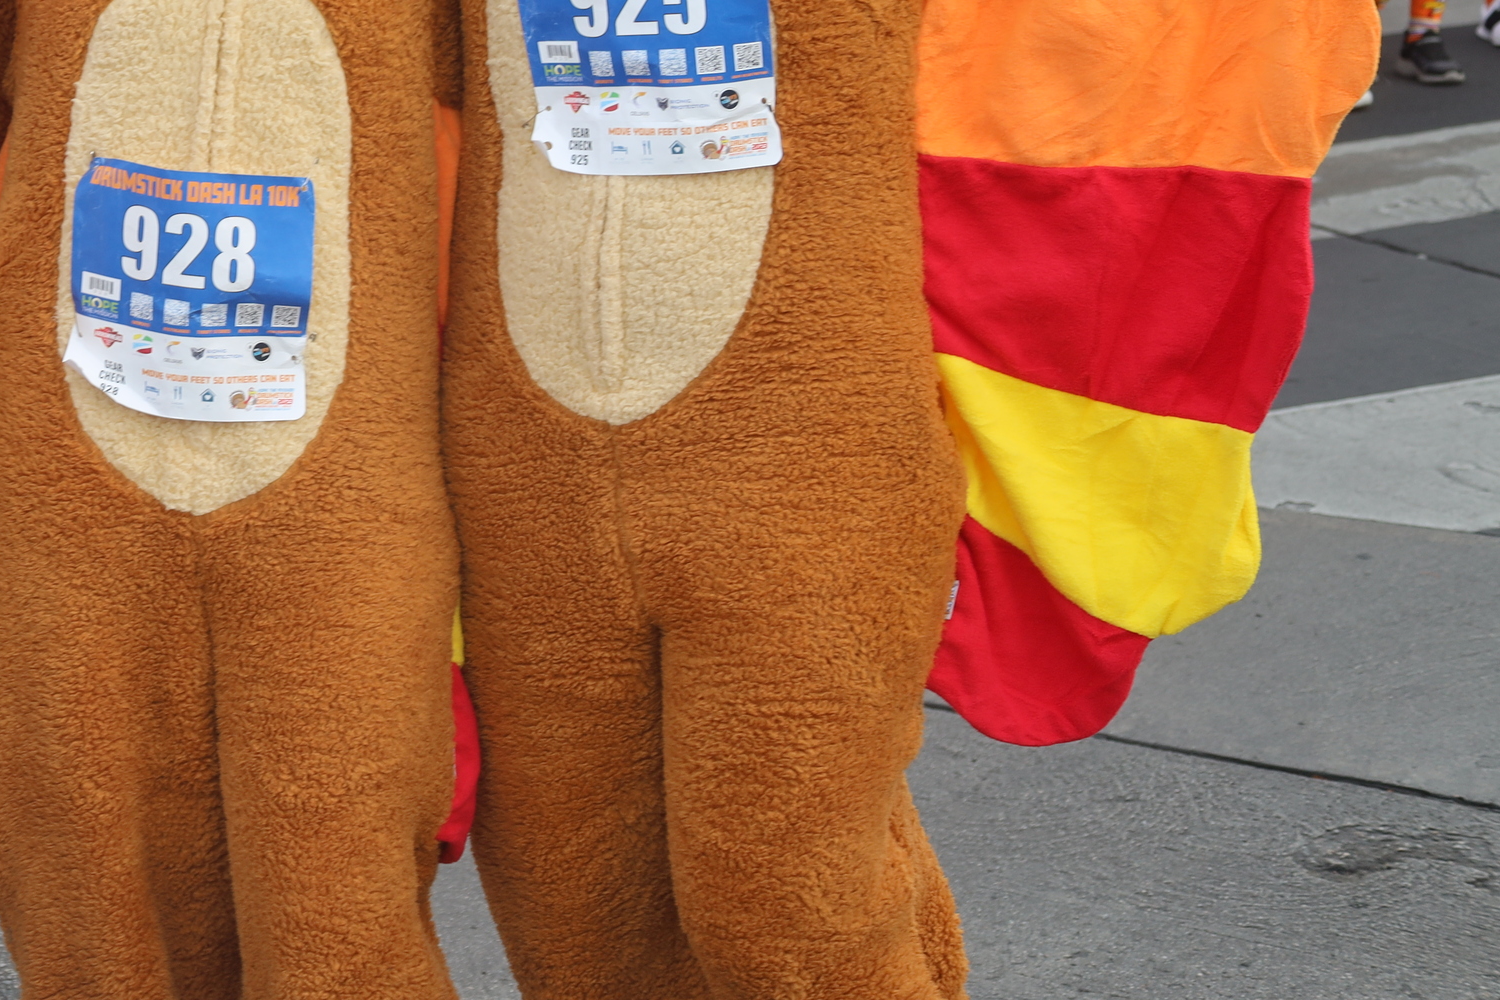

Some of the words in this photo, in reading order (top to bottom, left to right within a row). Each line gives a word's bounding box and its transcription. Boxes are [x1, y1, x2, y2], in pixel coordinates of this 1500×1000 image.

[545, 65, 582, 76] HOPE
[570, 127, 590, 138] GEAR
[608, 127, 631, 136] MOVE
[633, 127, 656, 136] YOUR
[657, 127, 678, 136] FEET
[680, 127, 692, 136] SO
[694, 122, 729, 135] OTHERS
[730, 120, 749, 130] CAN
[750, 118, 768, 127] EAT
[568, 139, 593, 151] CHECK
[570, 154, 589, 166] 925
[90, 165, 183, 202] DRUMSTICK
[186, 181, 235, 205] DASH
[239, 183, 264, 206] LA
[267, 185, 301, 207] 10K
[120, 204, 257, 293] 928
[81, 295, 119, 314] HOPE
[104, 359, 123, 372] GEAR
[98, 370, 126, 385] CHECK
[141, 368, 164, 379] MOVE
[165, 372, 189, 382] YOUR
[190, 375, 211, 384] FEET
[213, 376, 224, 384] SO
[226, 375, 258, 384] OTHERS
[260, 374, 277, 382] CAN
[279, 374, 295, 382] EAT
[100, 382, 119, 396] 928
